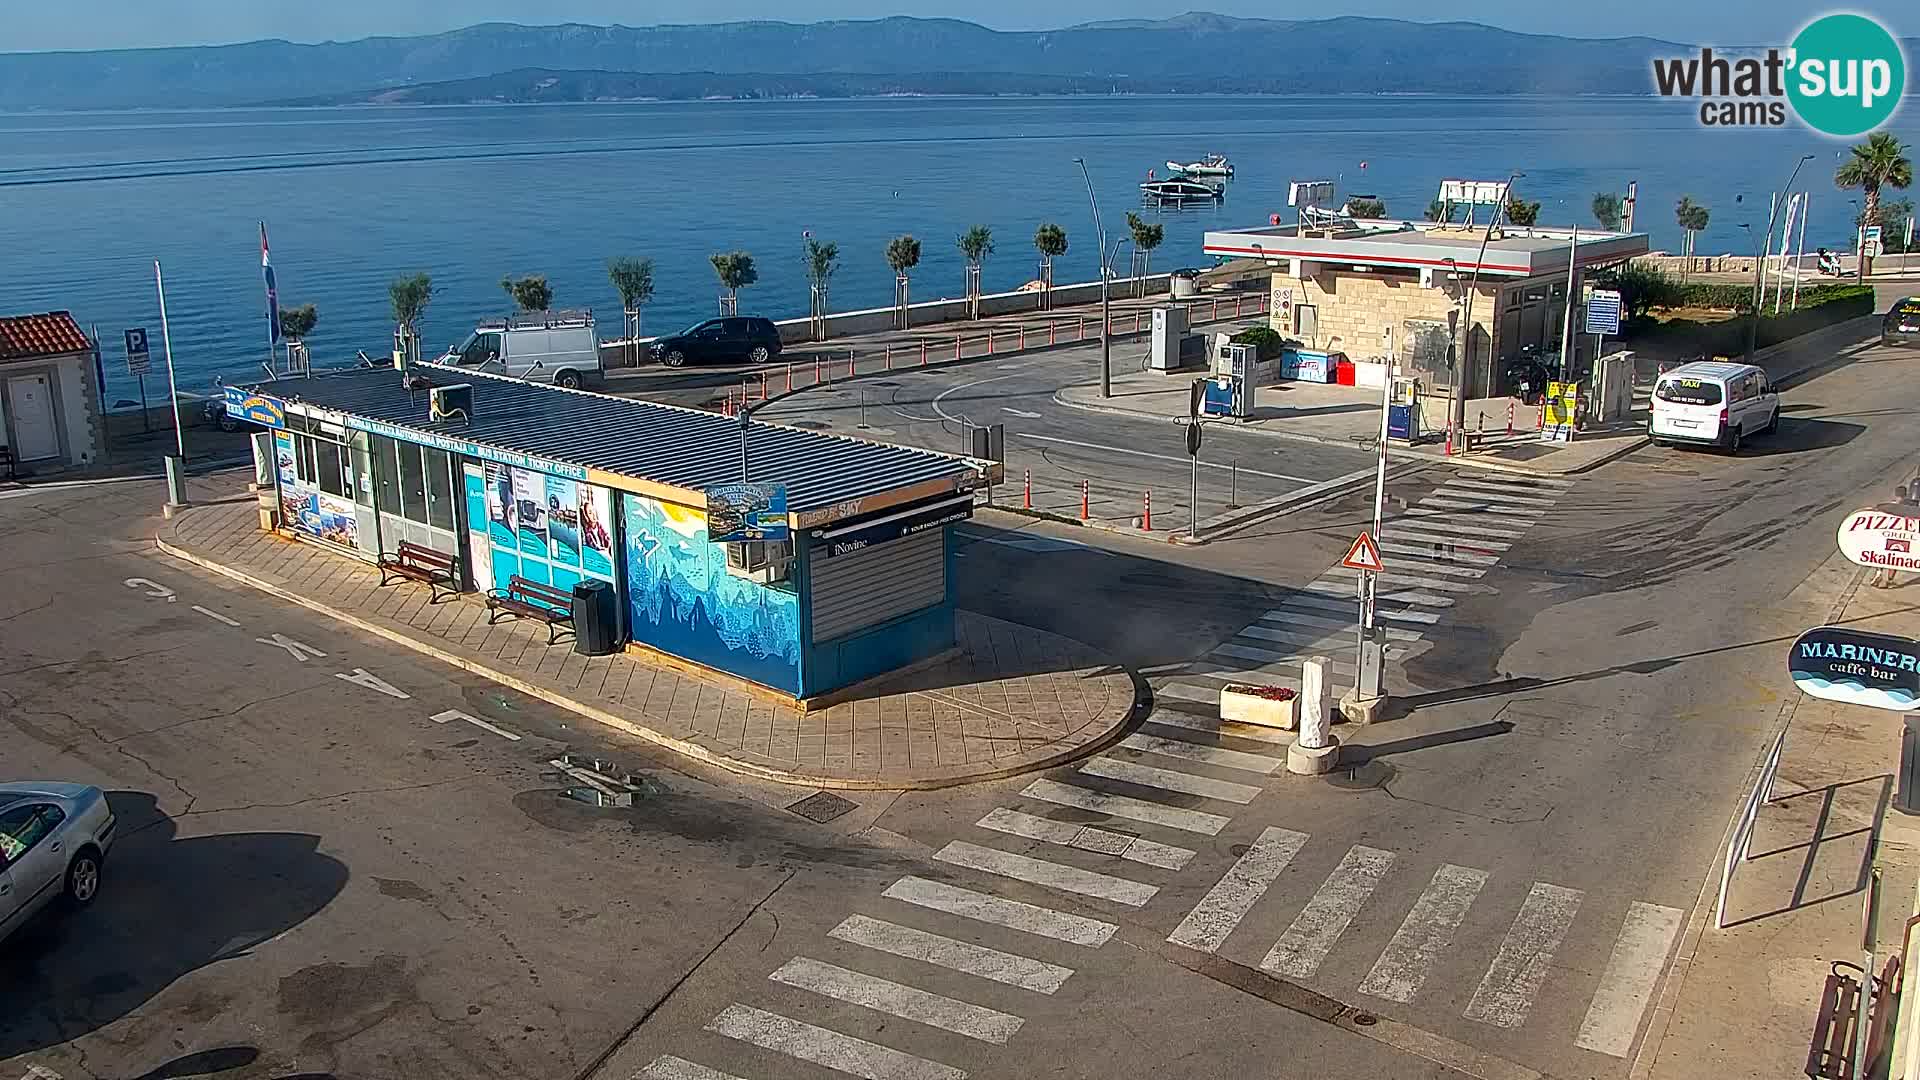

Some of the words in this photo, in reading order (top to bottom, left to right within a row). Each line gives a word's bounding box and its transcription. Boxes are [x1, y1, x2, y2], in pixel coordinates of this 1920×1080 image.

[130, 332, 142, 350] P
[1681, 380, 1701, 389] TAXI
[436, 438, 468, 452] POSTAJA
[478, 446, 493, 459] BUS
[493, 449, 526, 466] STATION
[527, 456, 554, 471] TICKET
[554, 462, 582, 478] OFFICE
[1849, 516, 1920, 533] PIZZE
[1882, 531, 1918, 541] GRILL
[835, 540, 868, 556] iNovine
[1829, 662, 1867, 676] caffe
[1870, 666, 1897, 680] bar
